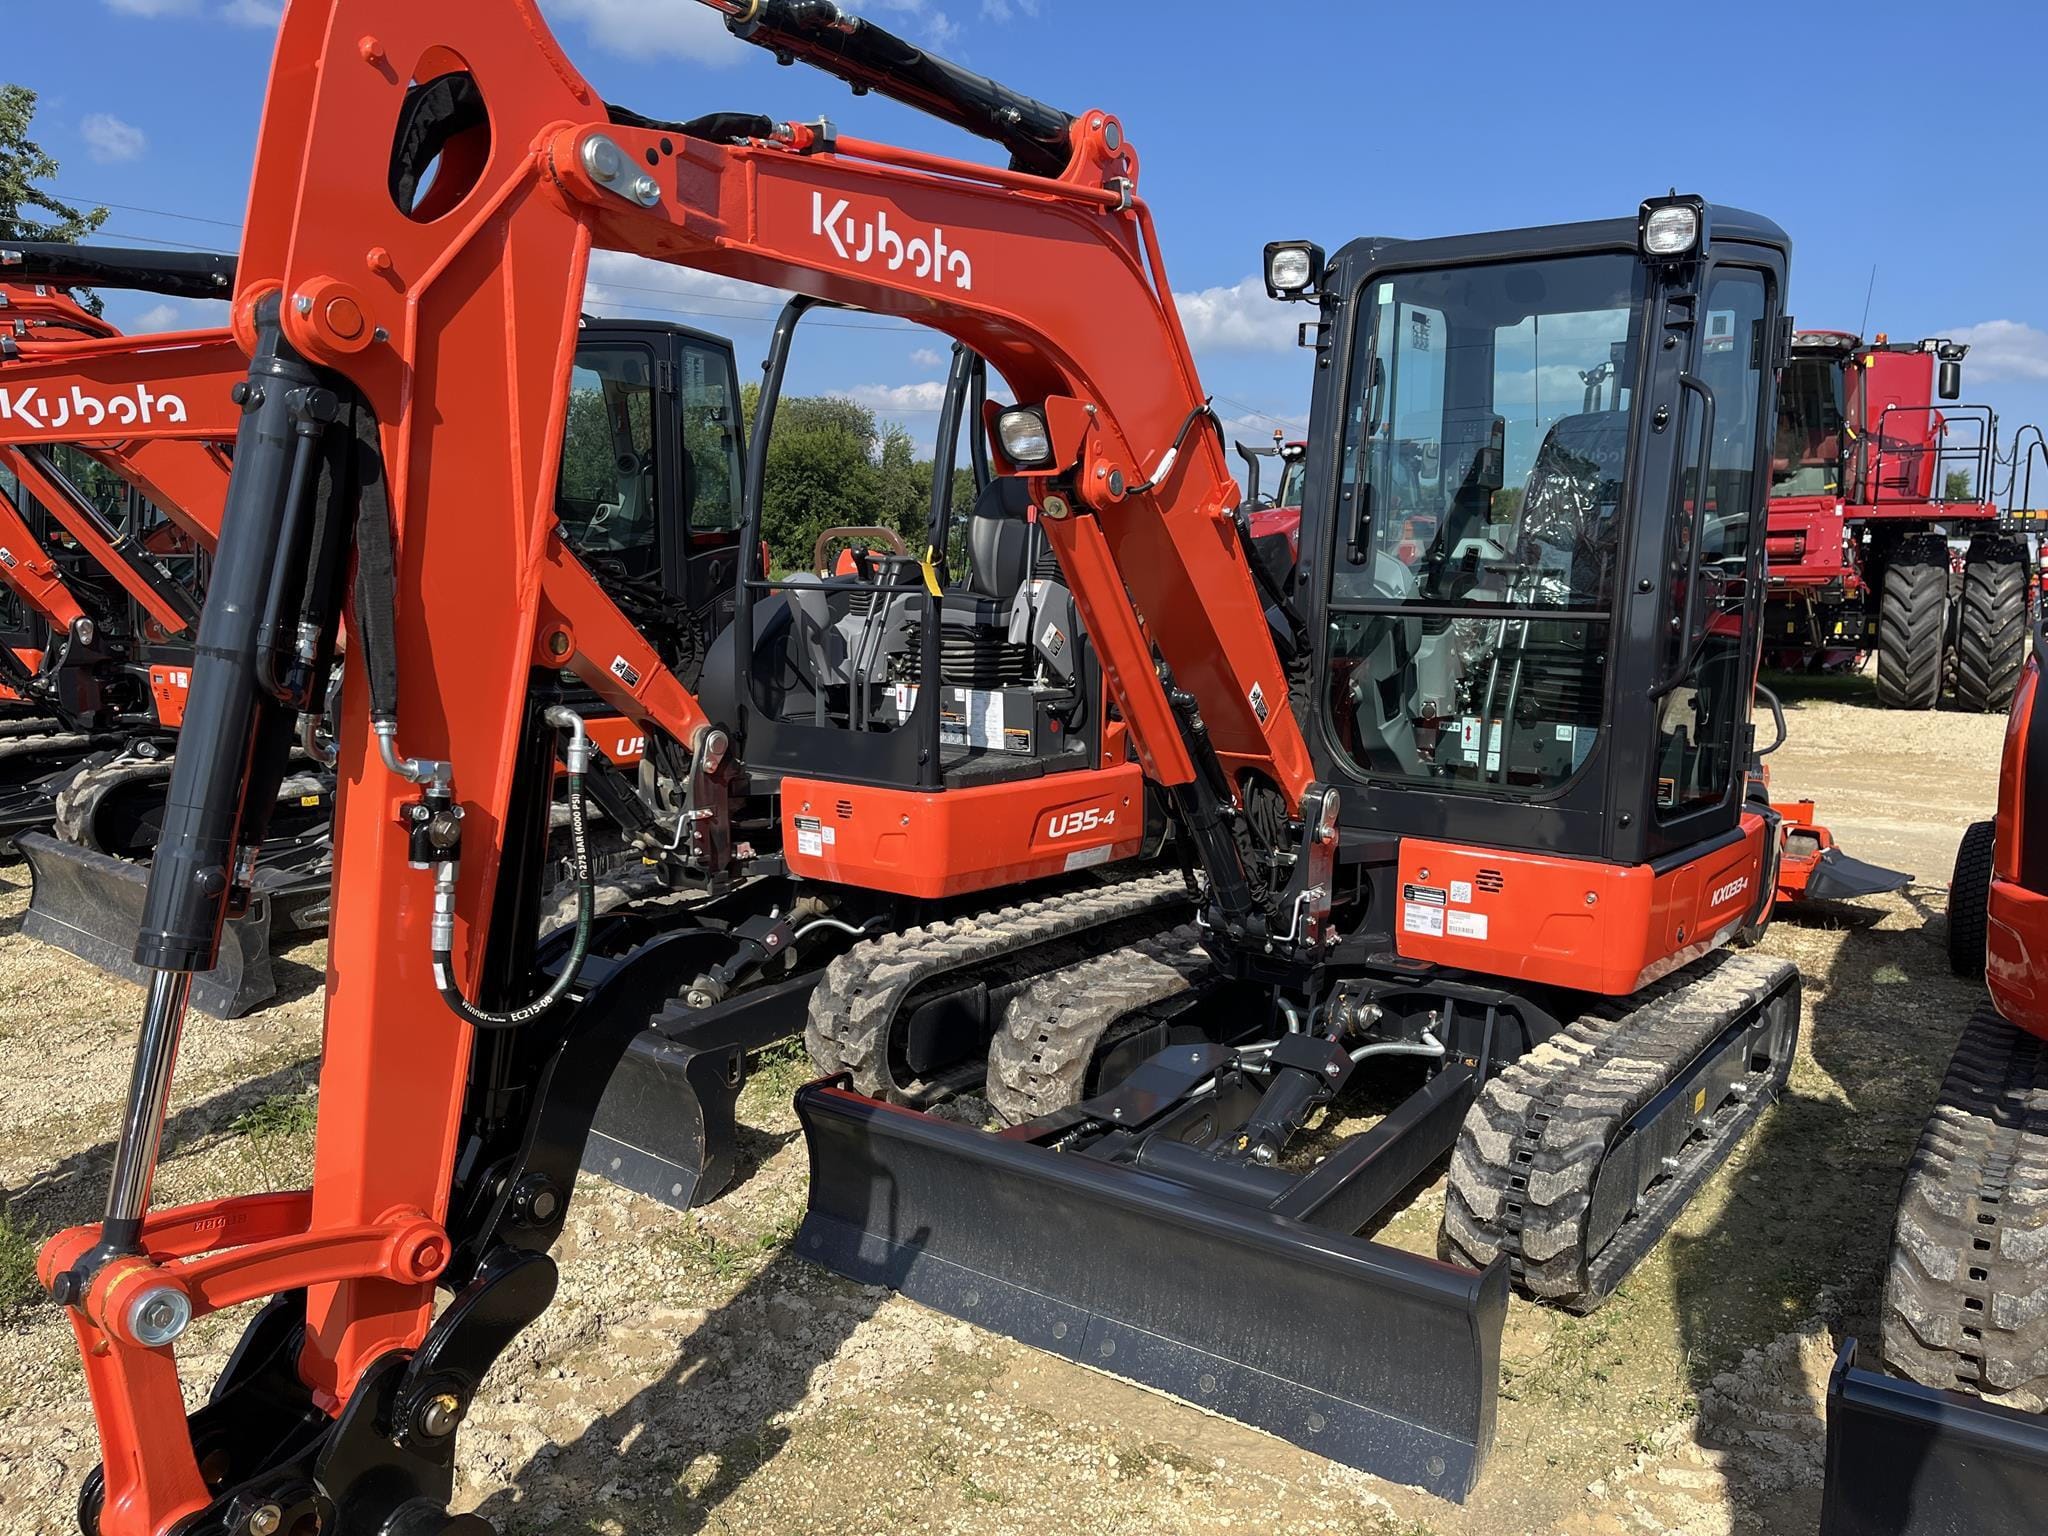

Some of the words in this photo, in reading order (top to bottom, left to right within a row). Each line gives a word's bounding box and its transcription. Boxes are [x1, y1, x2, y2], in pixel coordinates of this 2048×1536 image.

[812, 191, 972, 290] Kubota
[0, 384, 187, 428] Kubota
[571, 793, 581, 810] PSI)
[572, 809, 585, 836] (4000
[1048, 807, 1115, 838] U35-4
[577, 836, 587, 852] BAR
[1710, 876, 1749, 907] KX033-4
[510, 995, 553, 1022] EC215-08
